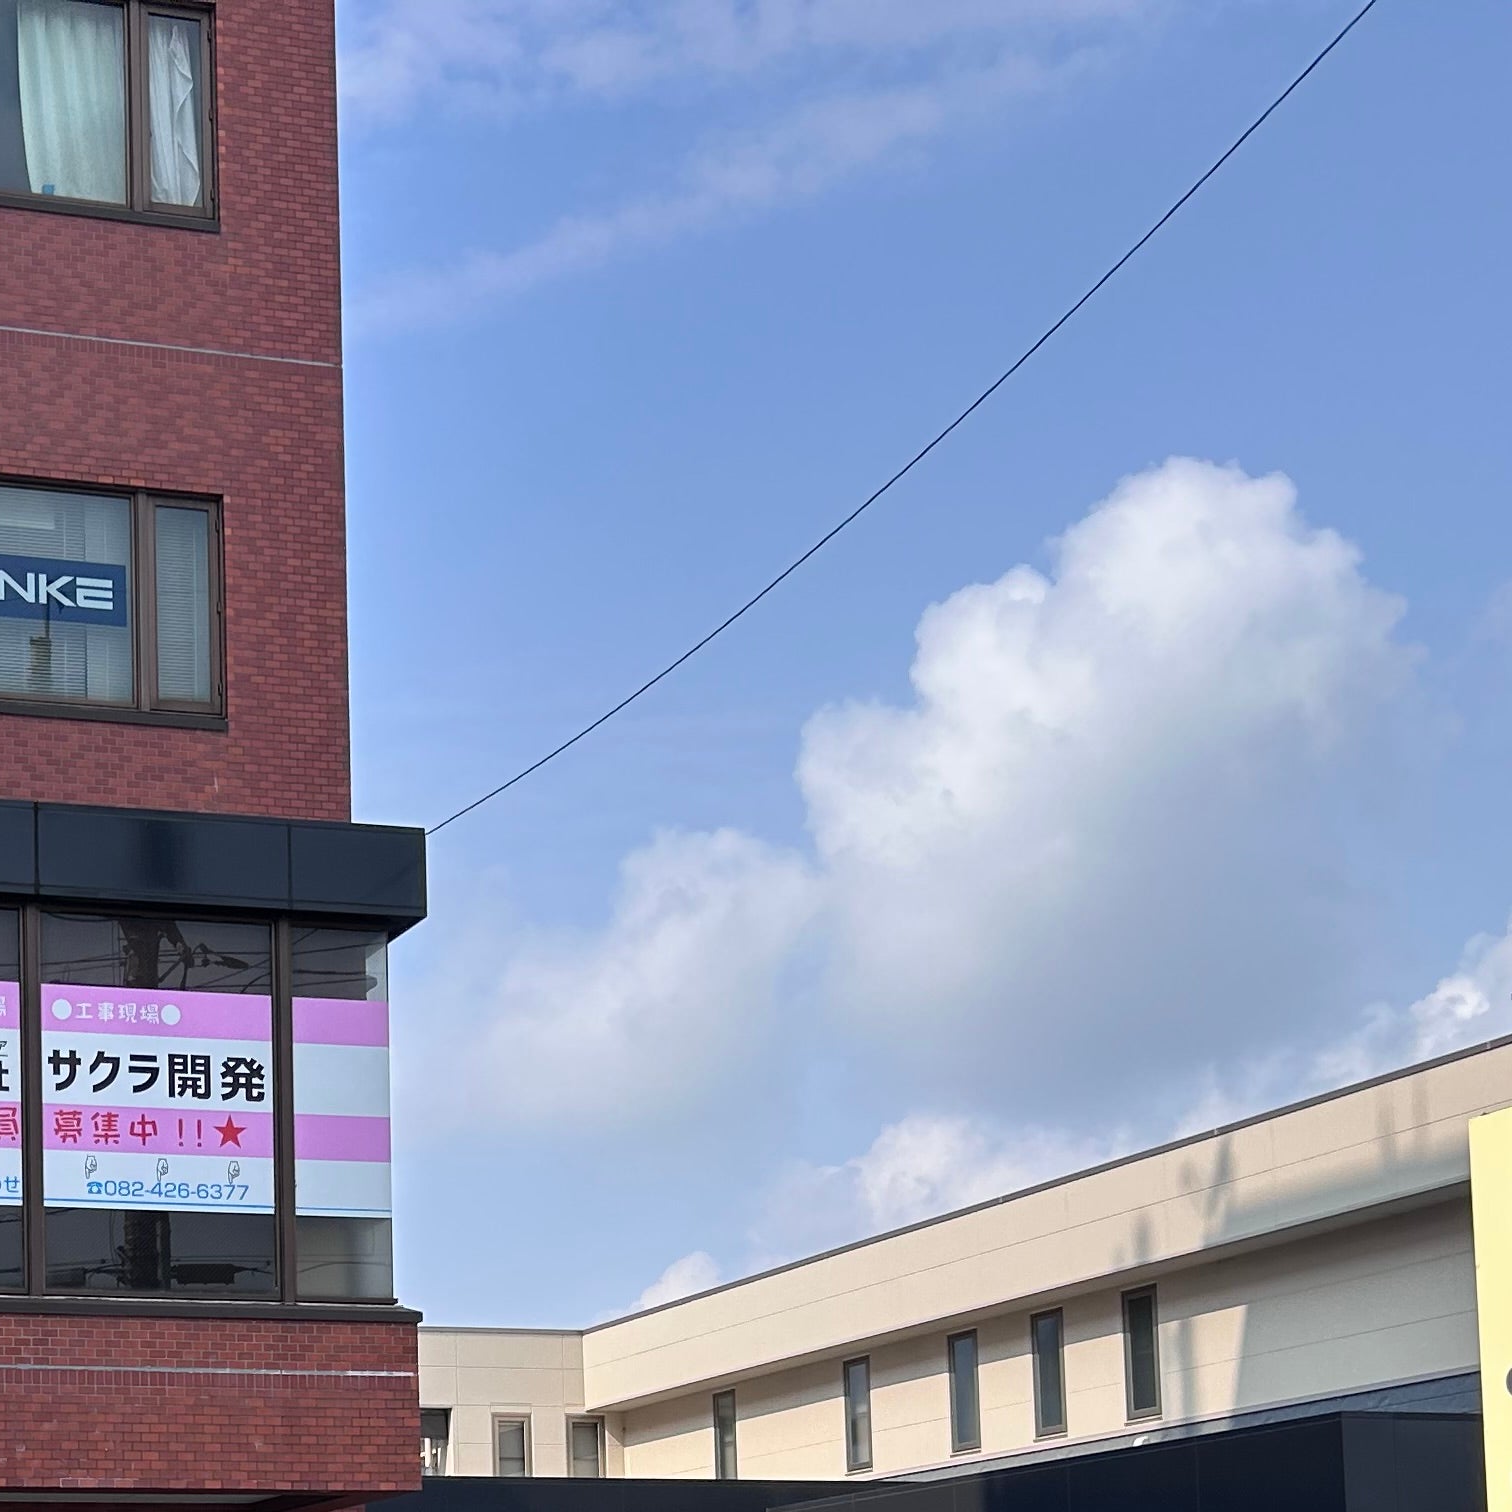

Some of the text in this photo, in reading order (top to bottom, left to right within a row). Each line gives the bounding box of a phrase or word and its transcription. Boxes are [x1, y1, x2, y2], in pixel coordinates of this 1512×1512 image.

[48, 1050, 266, 1102] サクラ開発
